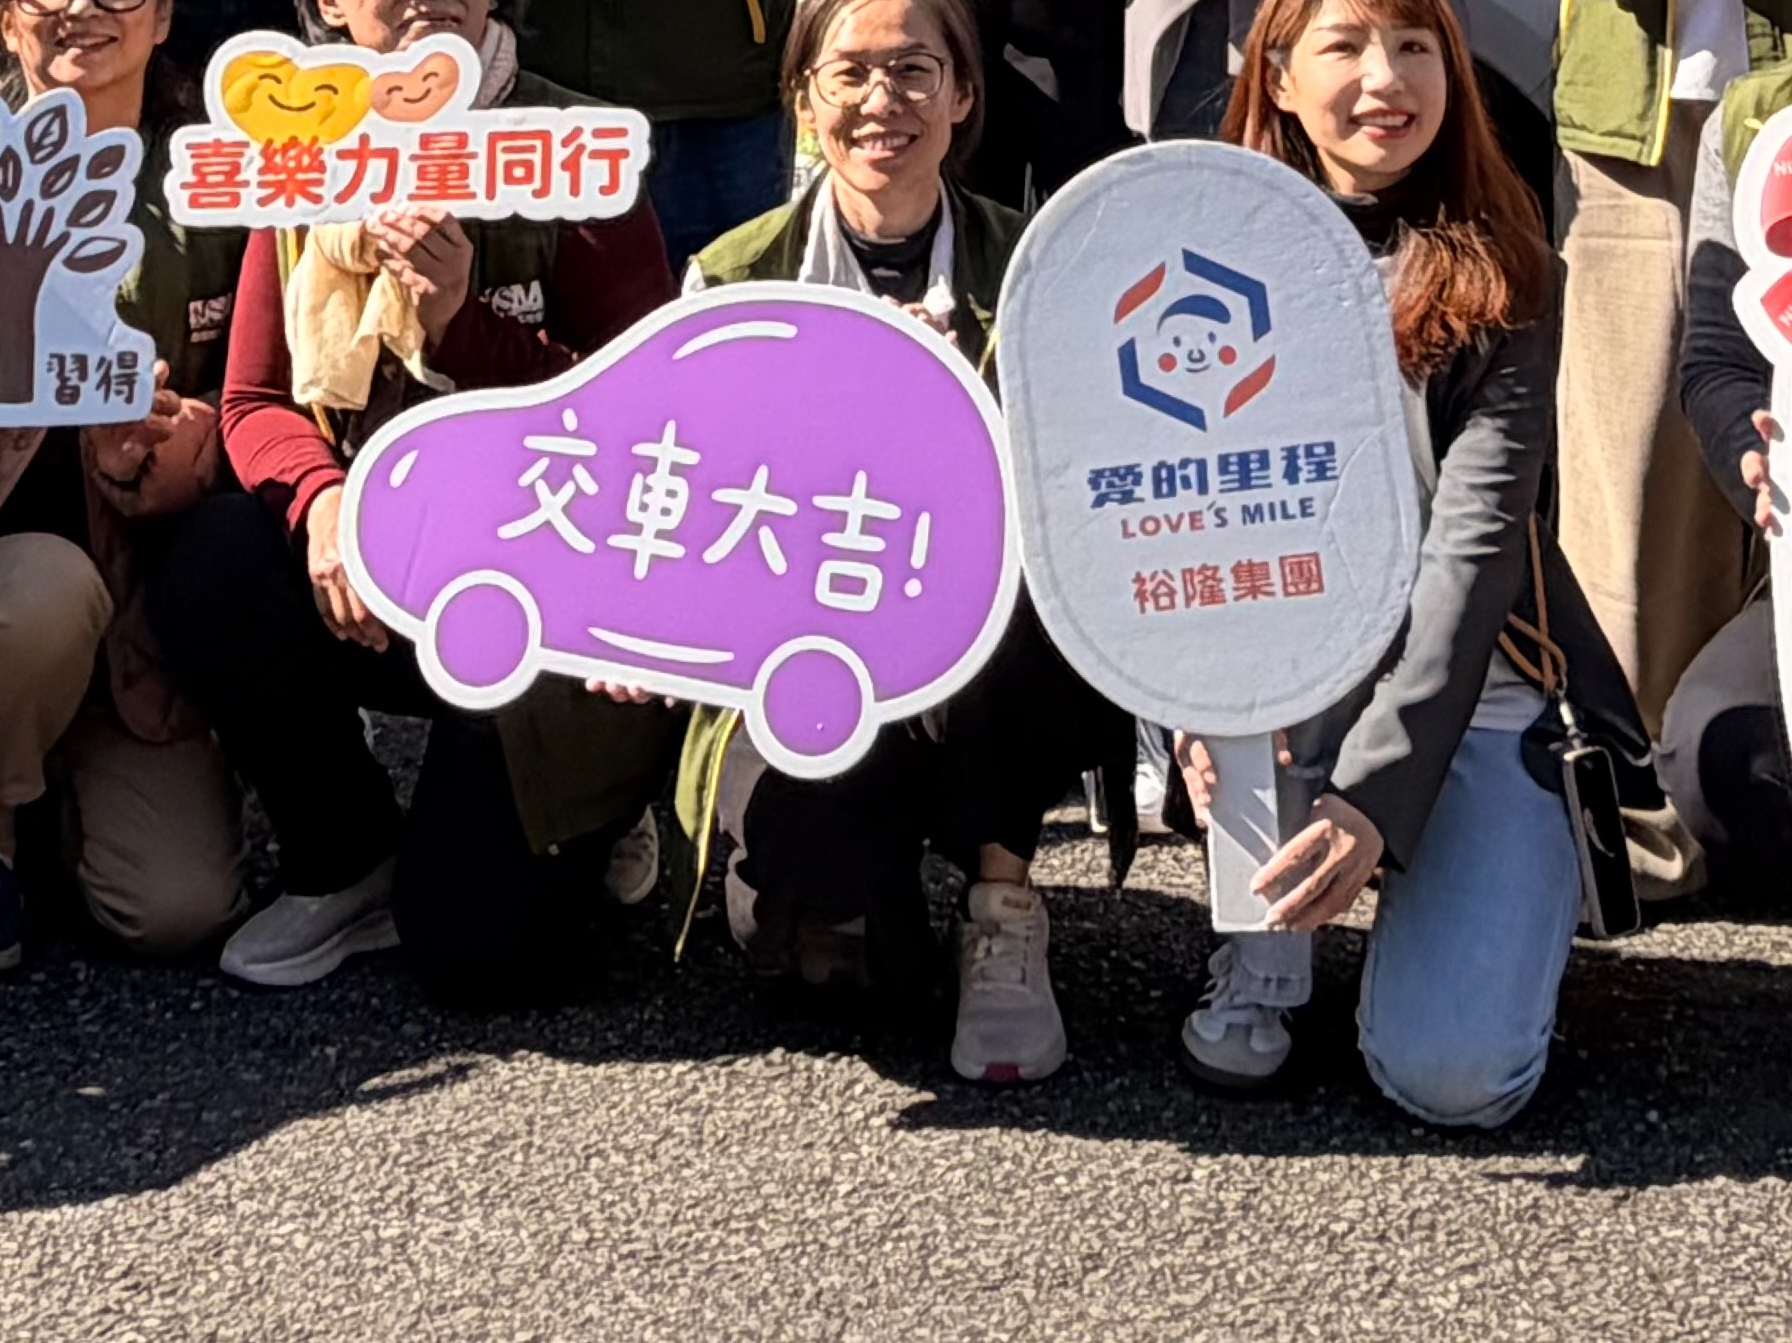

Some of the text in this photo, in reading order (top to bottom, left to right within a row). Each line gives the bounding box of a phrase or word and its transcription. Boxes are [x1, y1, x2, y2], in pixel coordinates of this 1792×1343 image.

[180, 125, 629, 211] 喜樂力量同行
[47, 351, 139, 405] 習得
[1088, 440, 1340, 509] 愛的里程
[1241, 497, 1316, 527] MILE
[1132, 552, 1325, 614] 裕隆集團
